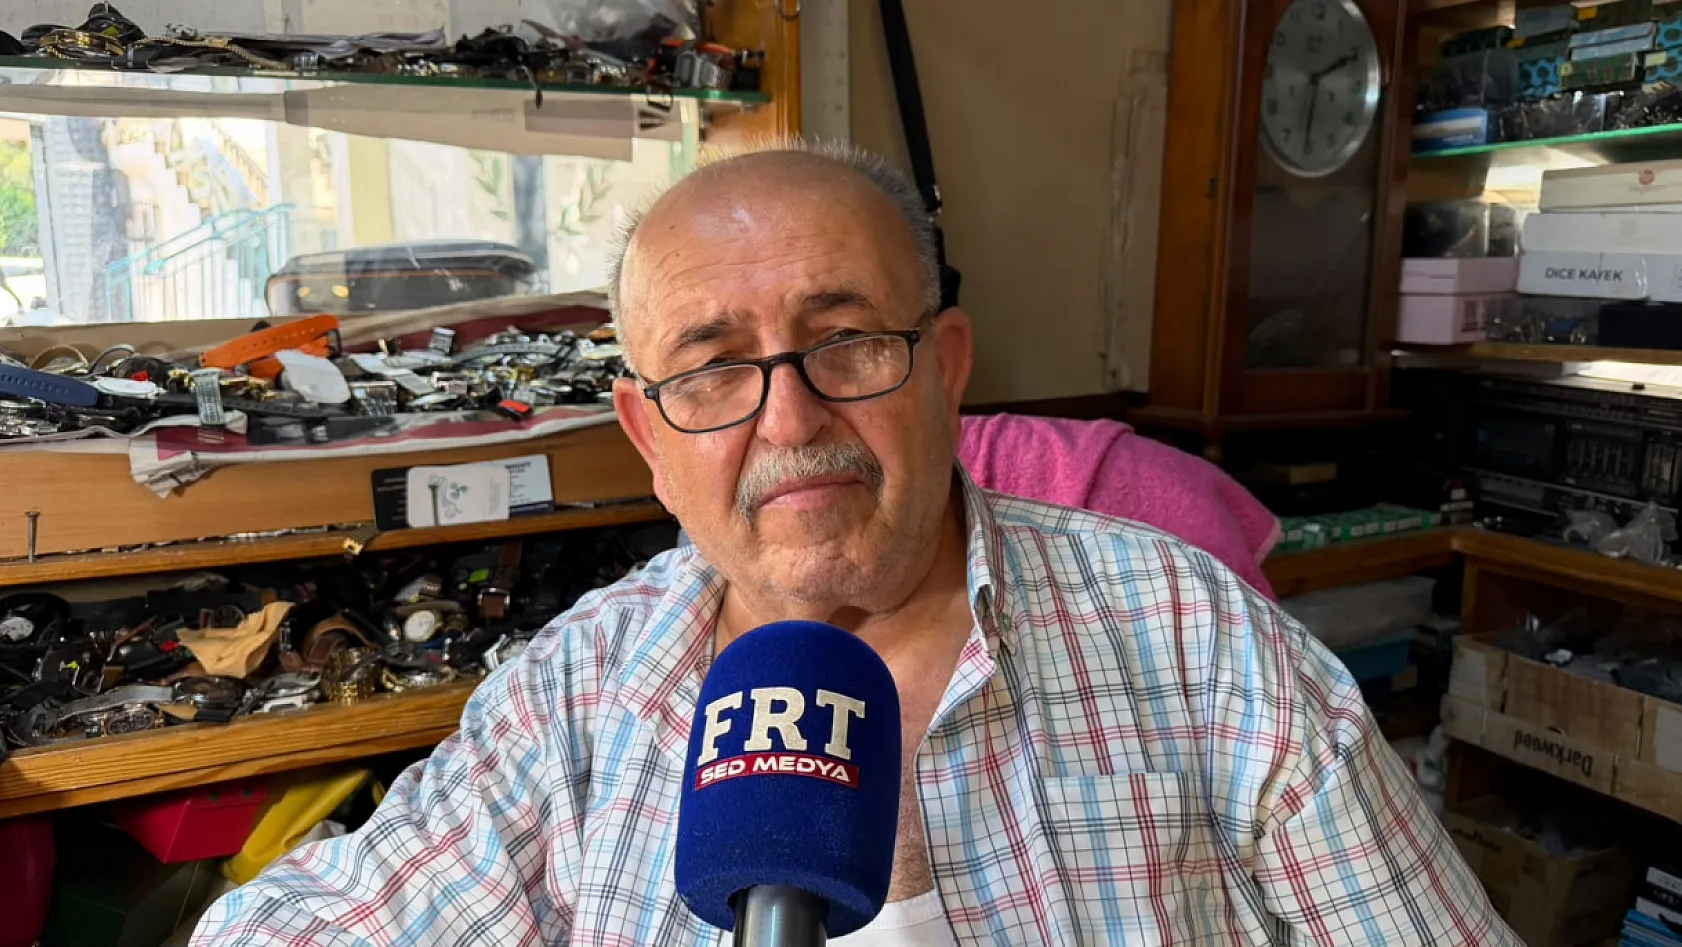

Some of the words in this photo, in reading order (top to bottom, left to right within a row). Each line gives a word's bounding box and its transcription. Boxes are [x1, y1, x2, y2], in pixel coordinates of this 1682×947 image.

[1544, 267, 1576, 280] DICE
[697, 686, 866, 767] FRT
[700, 760, 746, 785] SED
[752, 756, 851, 783] MEDYA
[1512, 730, 1594, 778] Darkwood
